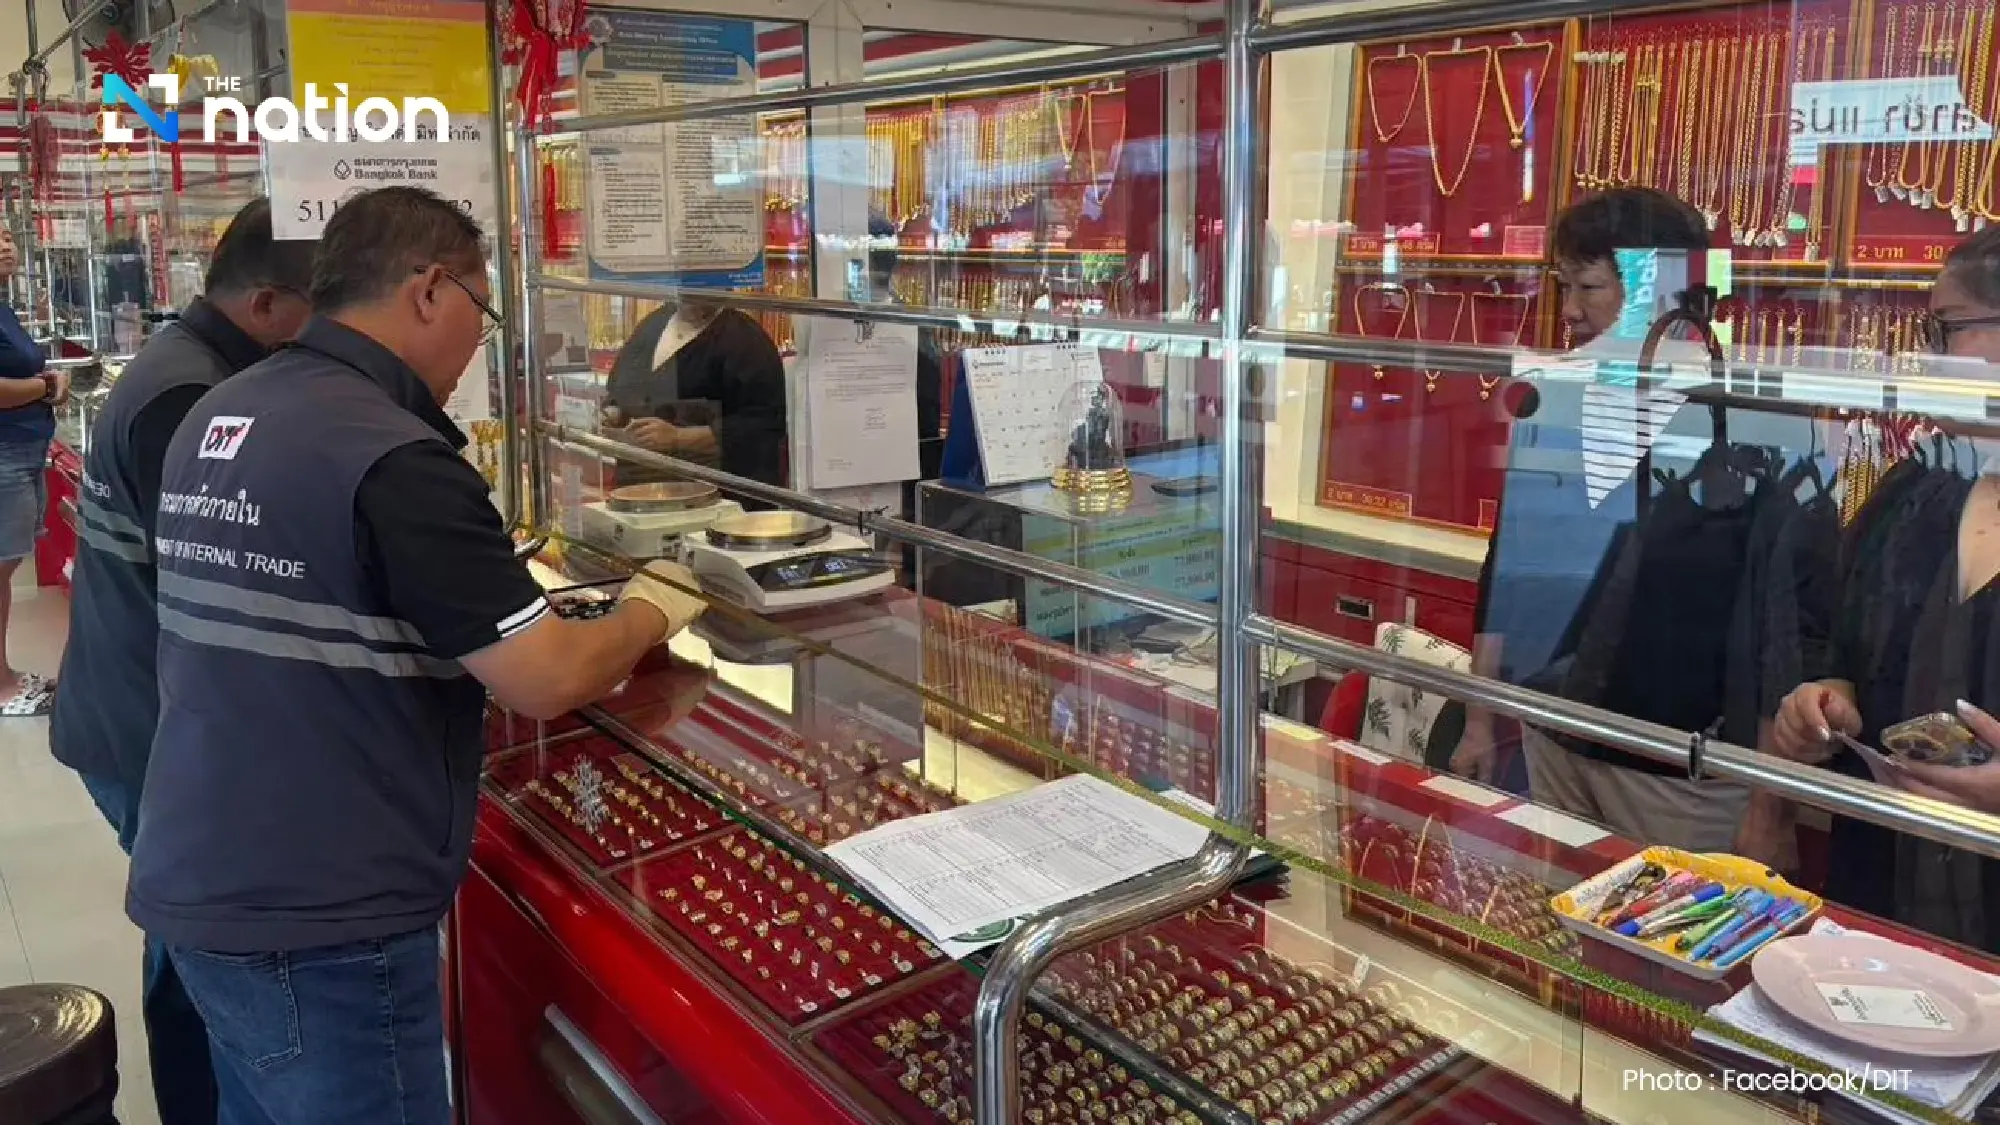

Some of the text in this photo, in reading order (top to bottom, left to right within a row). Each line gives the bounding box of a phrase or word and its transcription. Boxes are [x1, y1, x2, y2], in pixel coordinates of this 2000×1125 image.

[354, 168, 437, 181] Bangkok Bank
[1857, 244, 1867, 258] 2
[1874, 246, 1904, 259] บาท
[183, 541, 239, 568] INTERNAL
[245, 551, 306, 579] TRADE
